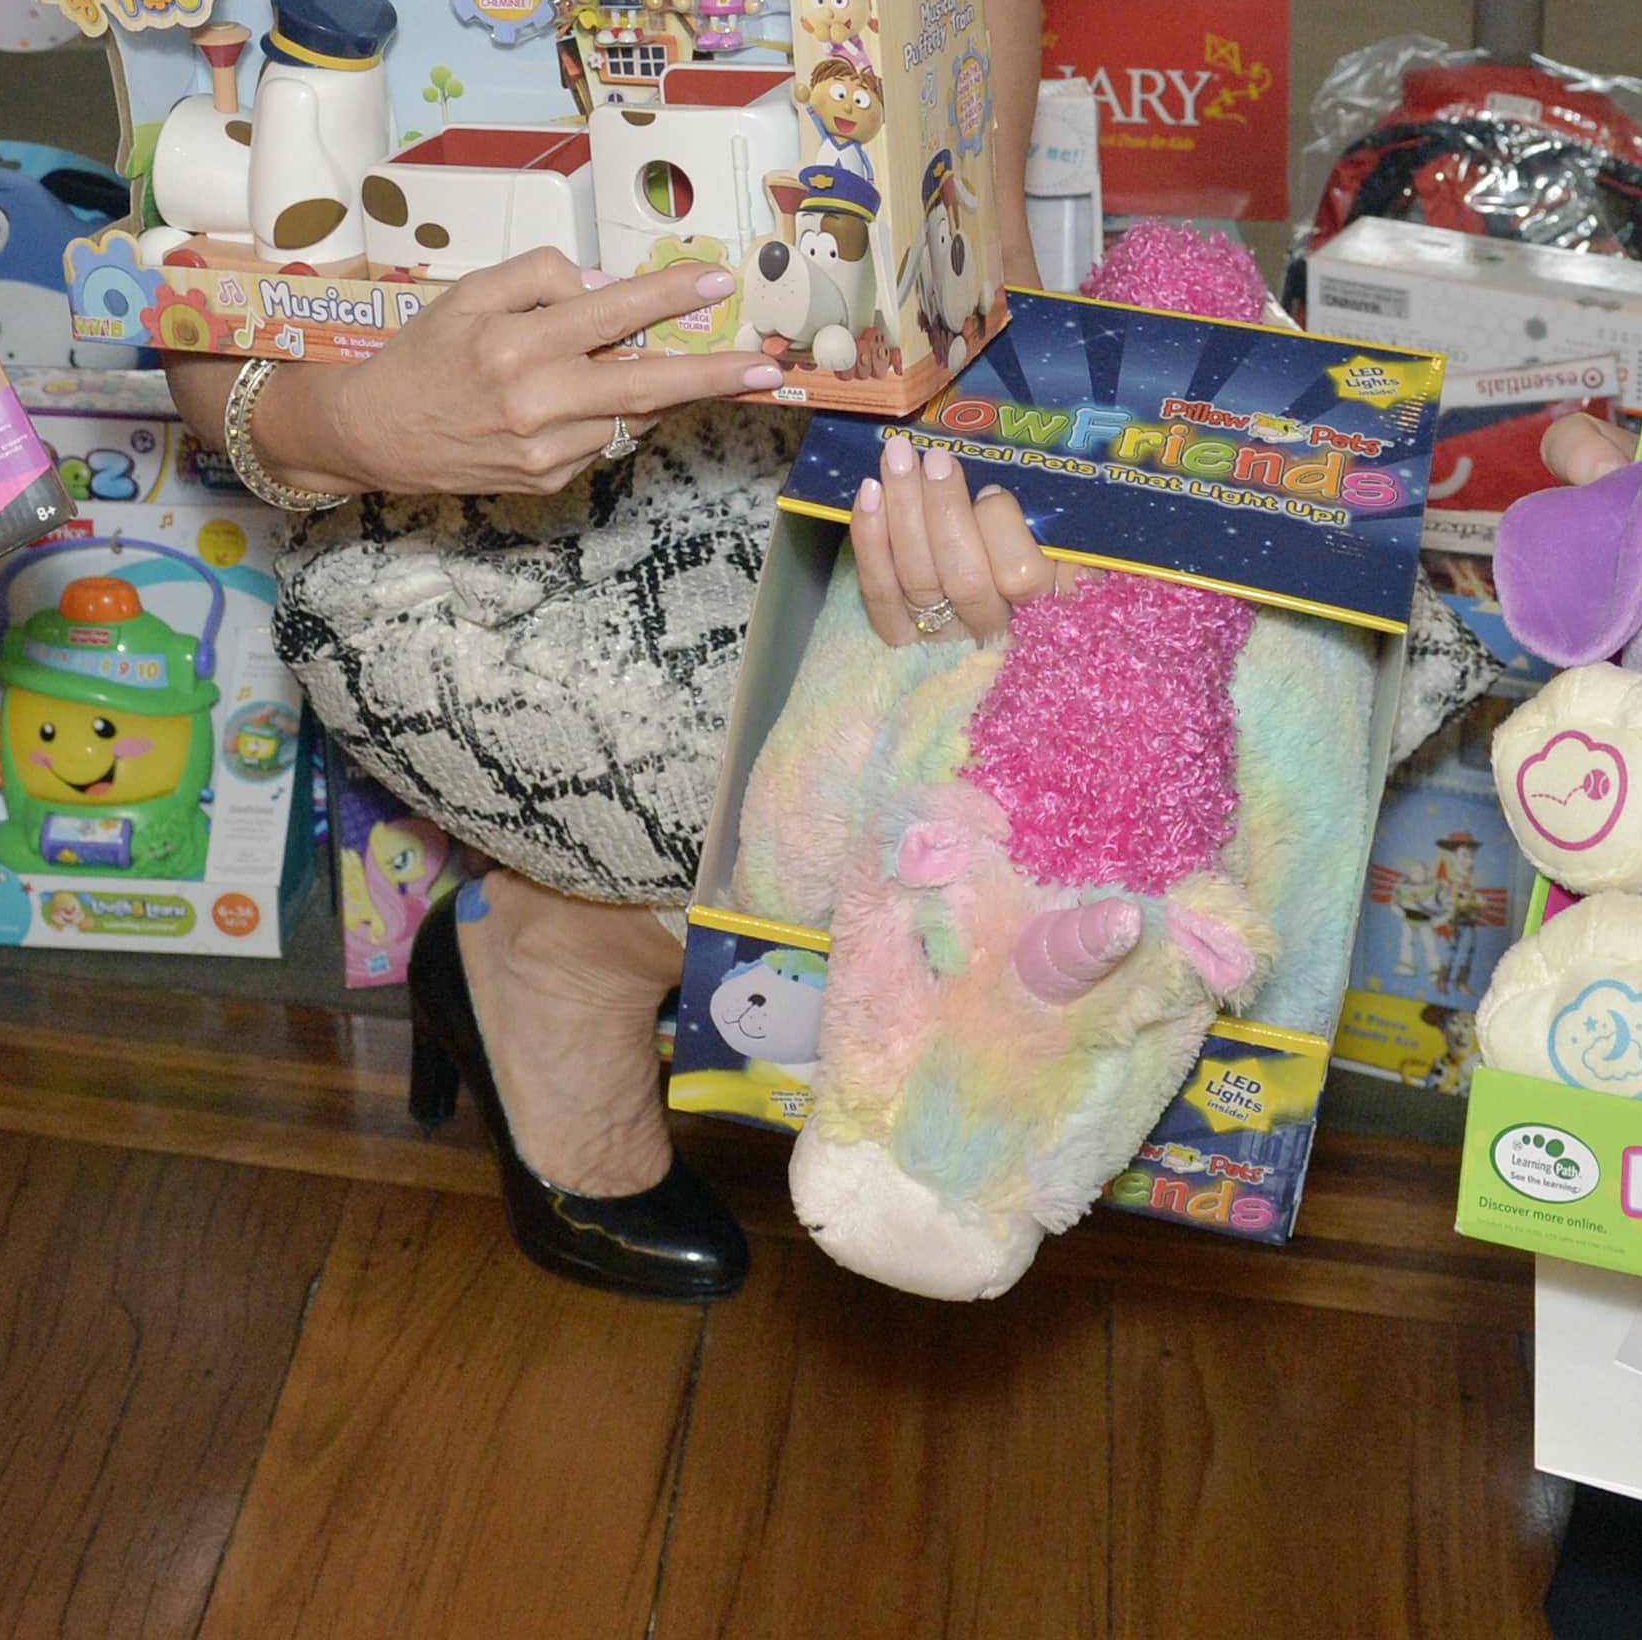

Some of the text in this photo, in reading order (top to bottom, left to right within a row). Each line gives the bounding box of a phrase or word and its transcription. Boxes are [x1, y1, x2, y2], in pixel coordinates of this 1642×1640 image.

[258, 280, 385, 329] Musical
[1345, 375, 1401, 391] Lights
[1348, 366, 1385, 378] LED
[1160, 396, 1383, 457] Pillow Pets
[1022, 450, 1095, 477] Pets
[1105, 464, 1182, 492] That
[1191, 481, 1277, 513] Light
[1287, 497, 1347, 524] Up!
[36, 504, 56, 522] 8+
[137, 662, 160, 679] 10
[1222, 1069, 1263, 1095] LED
[1204, 1079, 1263, 1113] Lights
[1206, 1100, 1250, 1122] inside!
[1208, 1157, 1265, 1183] Pets
[1510, 1171, 1526, 1182] See
[1526, 1174, 1542, 1186] the
[1511, 1153, 1579, 1180] Learning Path
[1478, 1195, 1608, 1234] Discover more online.
